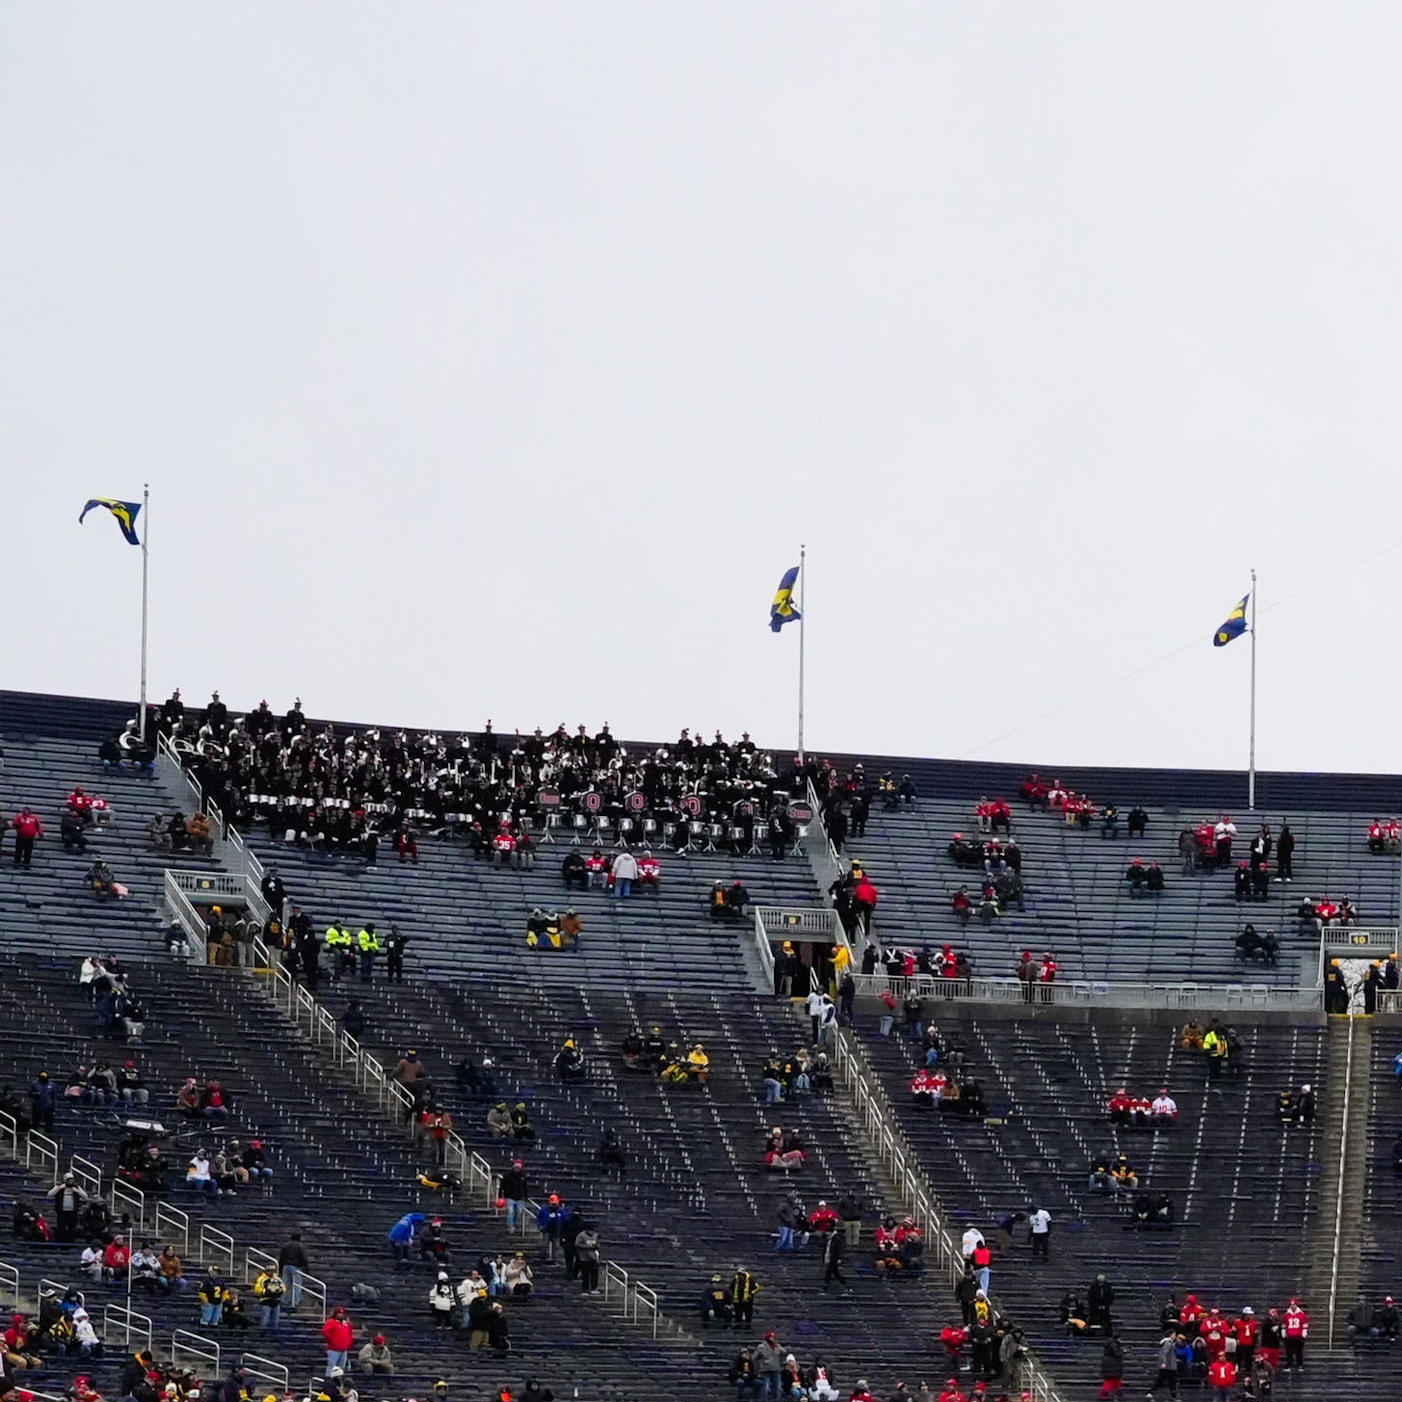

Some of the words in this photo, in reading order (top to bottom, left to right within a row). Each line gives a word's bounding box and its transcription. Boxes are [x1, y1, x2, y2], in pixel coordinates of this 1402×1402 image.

[1354, 935, 1367, 945] 10
[1288, 1317, 1300, 1329] 13
[1219, 1366, 1226, 1378] 1
